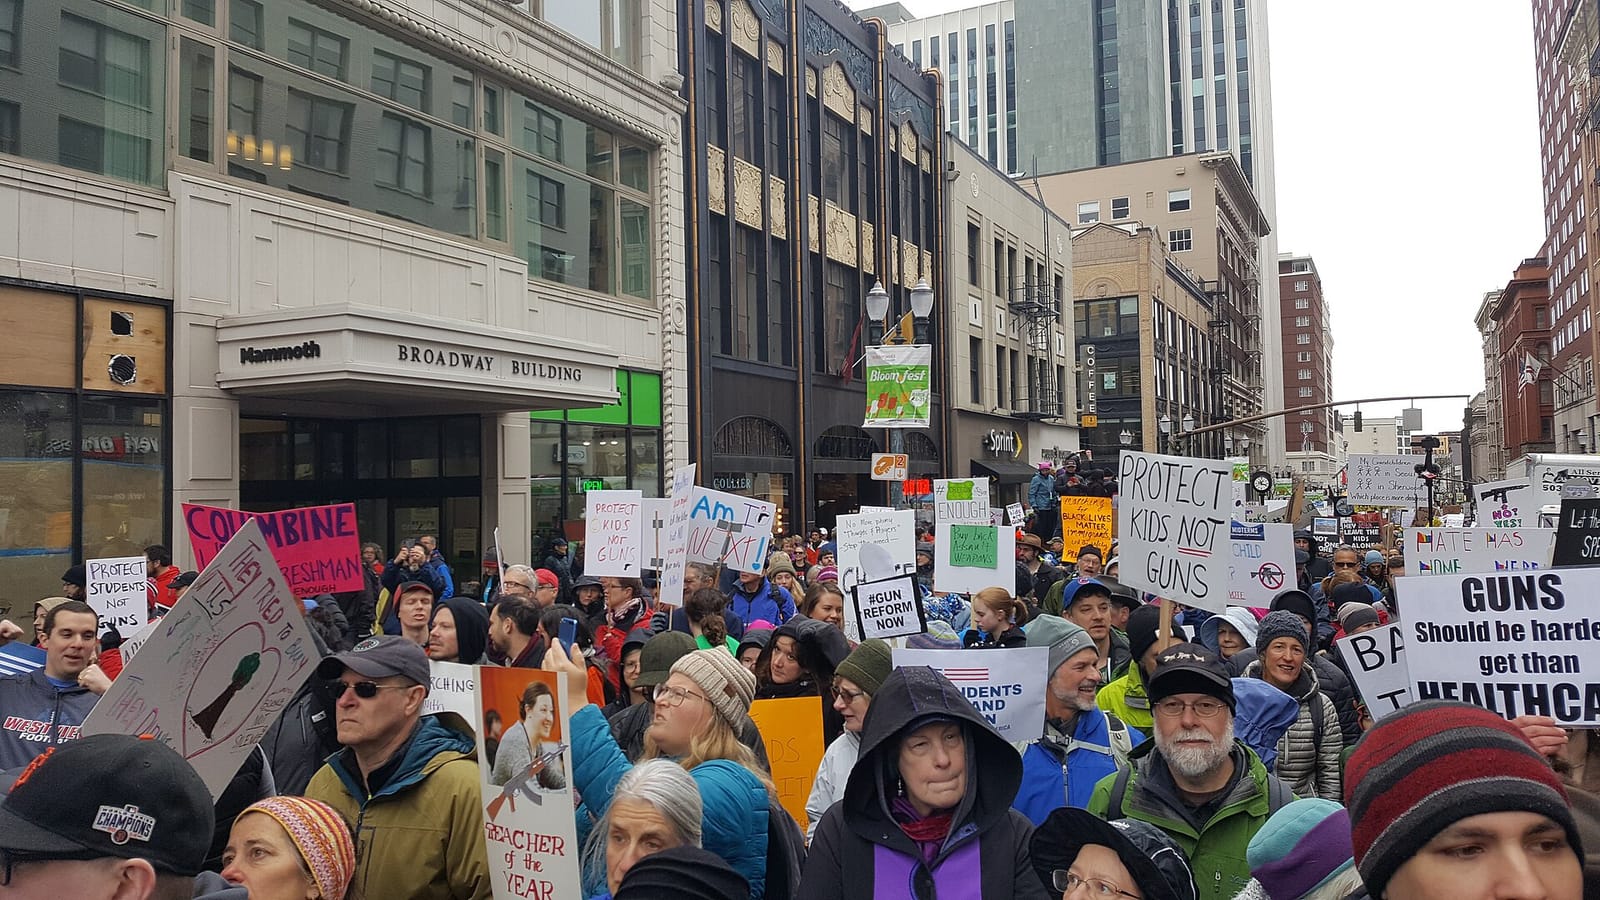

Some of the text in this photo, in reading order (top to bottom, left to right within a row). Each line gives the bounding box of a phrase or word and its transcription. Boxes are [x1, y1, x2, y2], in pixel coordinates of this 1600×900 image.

[240, 341, 321, 365] Mammoth
[398, 345, 582, 382] BROADWAY BUILDING
[1086, 346, 1096, 413] COFFEE
[990, 429, 1014, 457] Sprint
[896, 456, 905, 466] 2
[713, 478, 751, 490] COLLIER
[1120, 454, 1229, 511] PROTECT
[595, 503, 639, 516] PROTECT
[938, 501, 987, 520] ENOUGH
[1062, 512, 1111, 522] BLACK LIVES
[602, 519, 631, 532] KIDS
[1130, 507, 1225, 552] KIDS NOT
[1232, 543, 1262, 559] CHILD
[1416, 530, 1524, 552] HATE HAS
[597, 546, 637, 562] GUNS
[90, 561, 145, 580] PROTECT
[229, 540, 262, 600] THEY
[277, 554, 360, 588] RESHMAN
[1147, 551, 1208, 599] GUNS
[90, 581, 146, 595] STUDENTS
[294, 584, 337, 596] ENOUGH
[868, 589, 902, 605] #GUN
[1461, 573, 1566, 613] GUNS
[98, 614, 138, 629] GUNS
[863, 601, 913, 619] REFORM
[876, 616, 905, 631] NOW
[1415, 620, 1491, 643] Should
[1496, 620, 1526, 642] be
[1479, 651, 1581, 676] get than
[3, 716, 86, 741] WESTIE
[96, 812, 152, 838] CHAMPIONS
[485, 821, 565, 857] TEACHER
[504, 849, 543, 873] of the
[503, 870, 554, 900] YEAR
